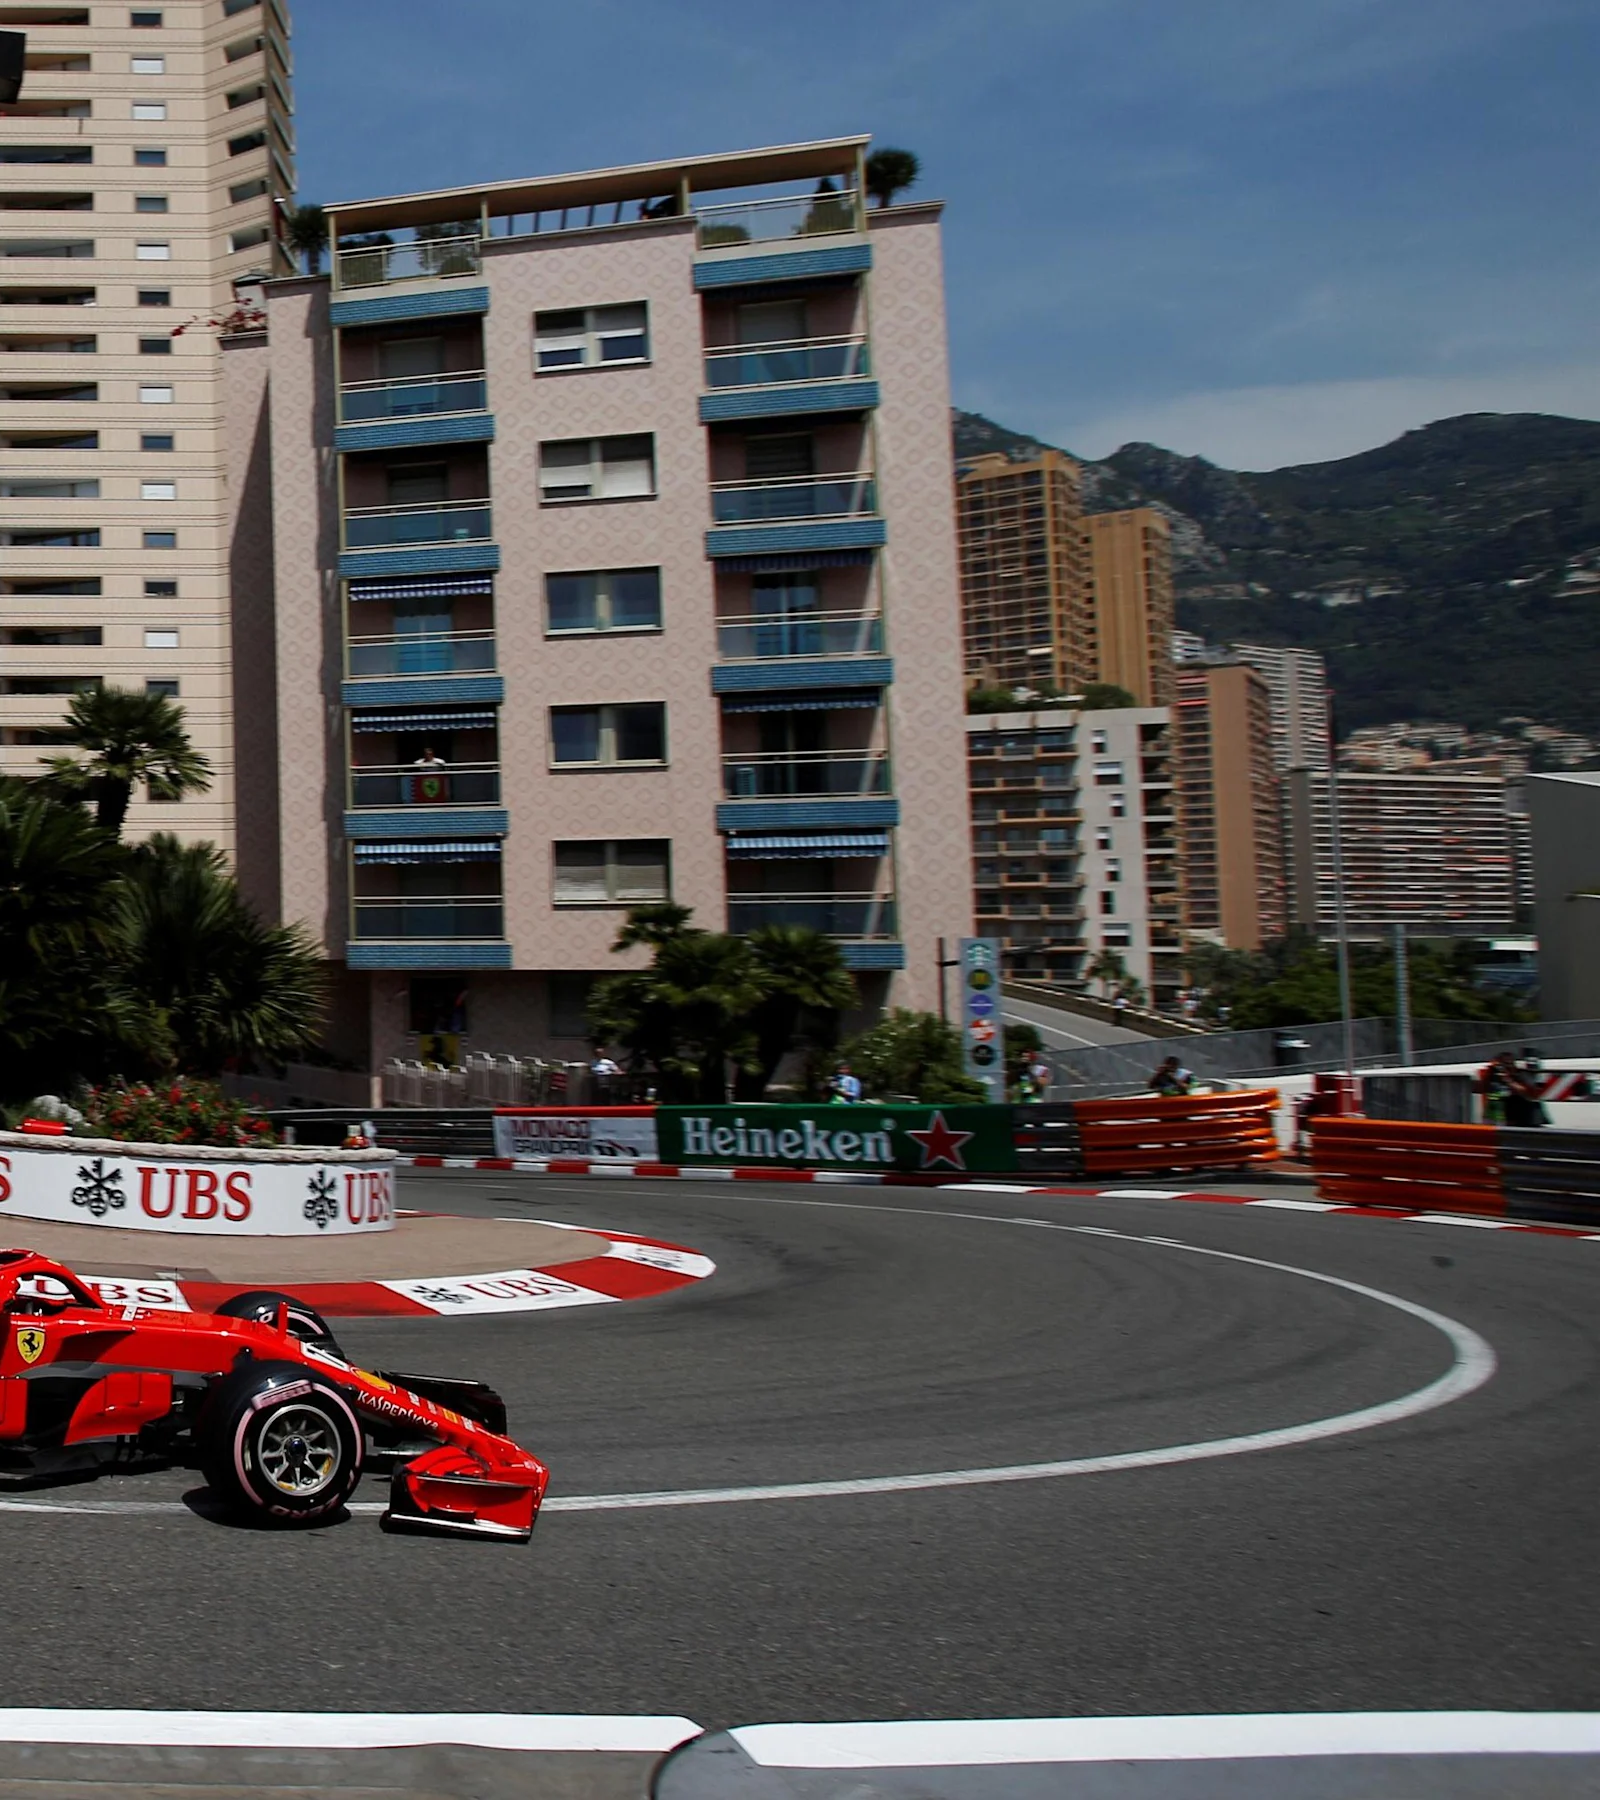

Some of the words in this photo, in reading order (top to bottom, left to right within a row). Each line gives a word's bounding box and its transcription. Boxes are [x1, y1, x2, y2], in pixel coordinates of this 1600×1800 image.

[511, 1119, 591, 1139] MONACO
[680, 1116, 898, 1163] Heineken
[138, 1166, 254, 1222] UBS
[460, 1276, 578, 1299] UBS
